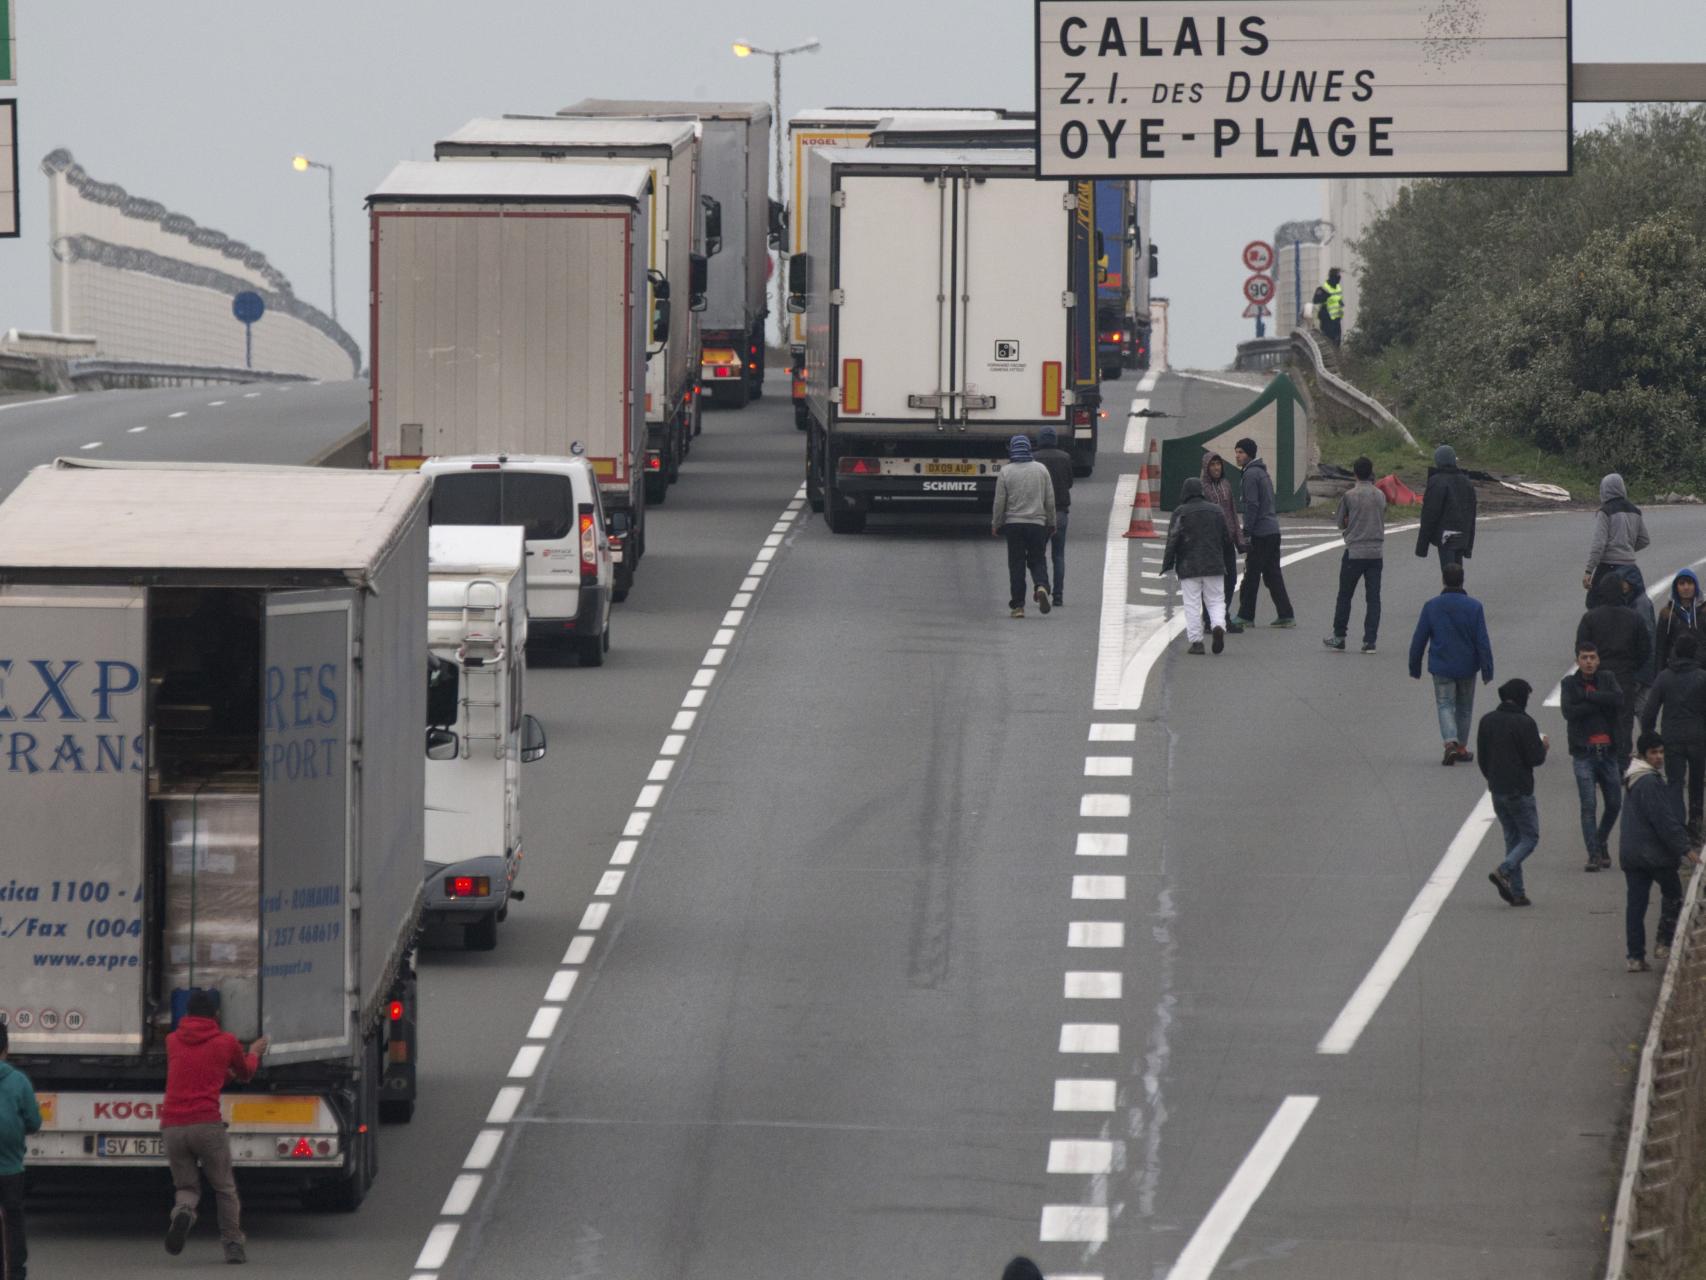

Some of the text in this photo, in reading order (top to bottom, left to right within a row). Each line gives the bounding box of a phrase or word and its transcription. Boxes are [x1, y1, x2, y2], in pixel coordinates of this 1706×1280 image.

[1060, 16, 1269, 57] CALAIS
[1152, 83, 1204, 103] DES
[1226, 70, 1375, 103] DUNES
[1250, 283, 1268, 297] 90
[923, 482, 977, 491] SCHMITZ
[51, 881, 110, 902] 1100
[106, 1140, 128, 1154] SV
[133, 1140, 148, 1153] 16
